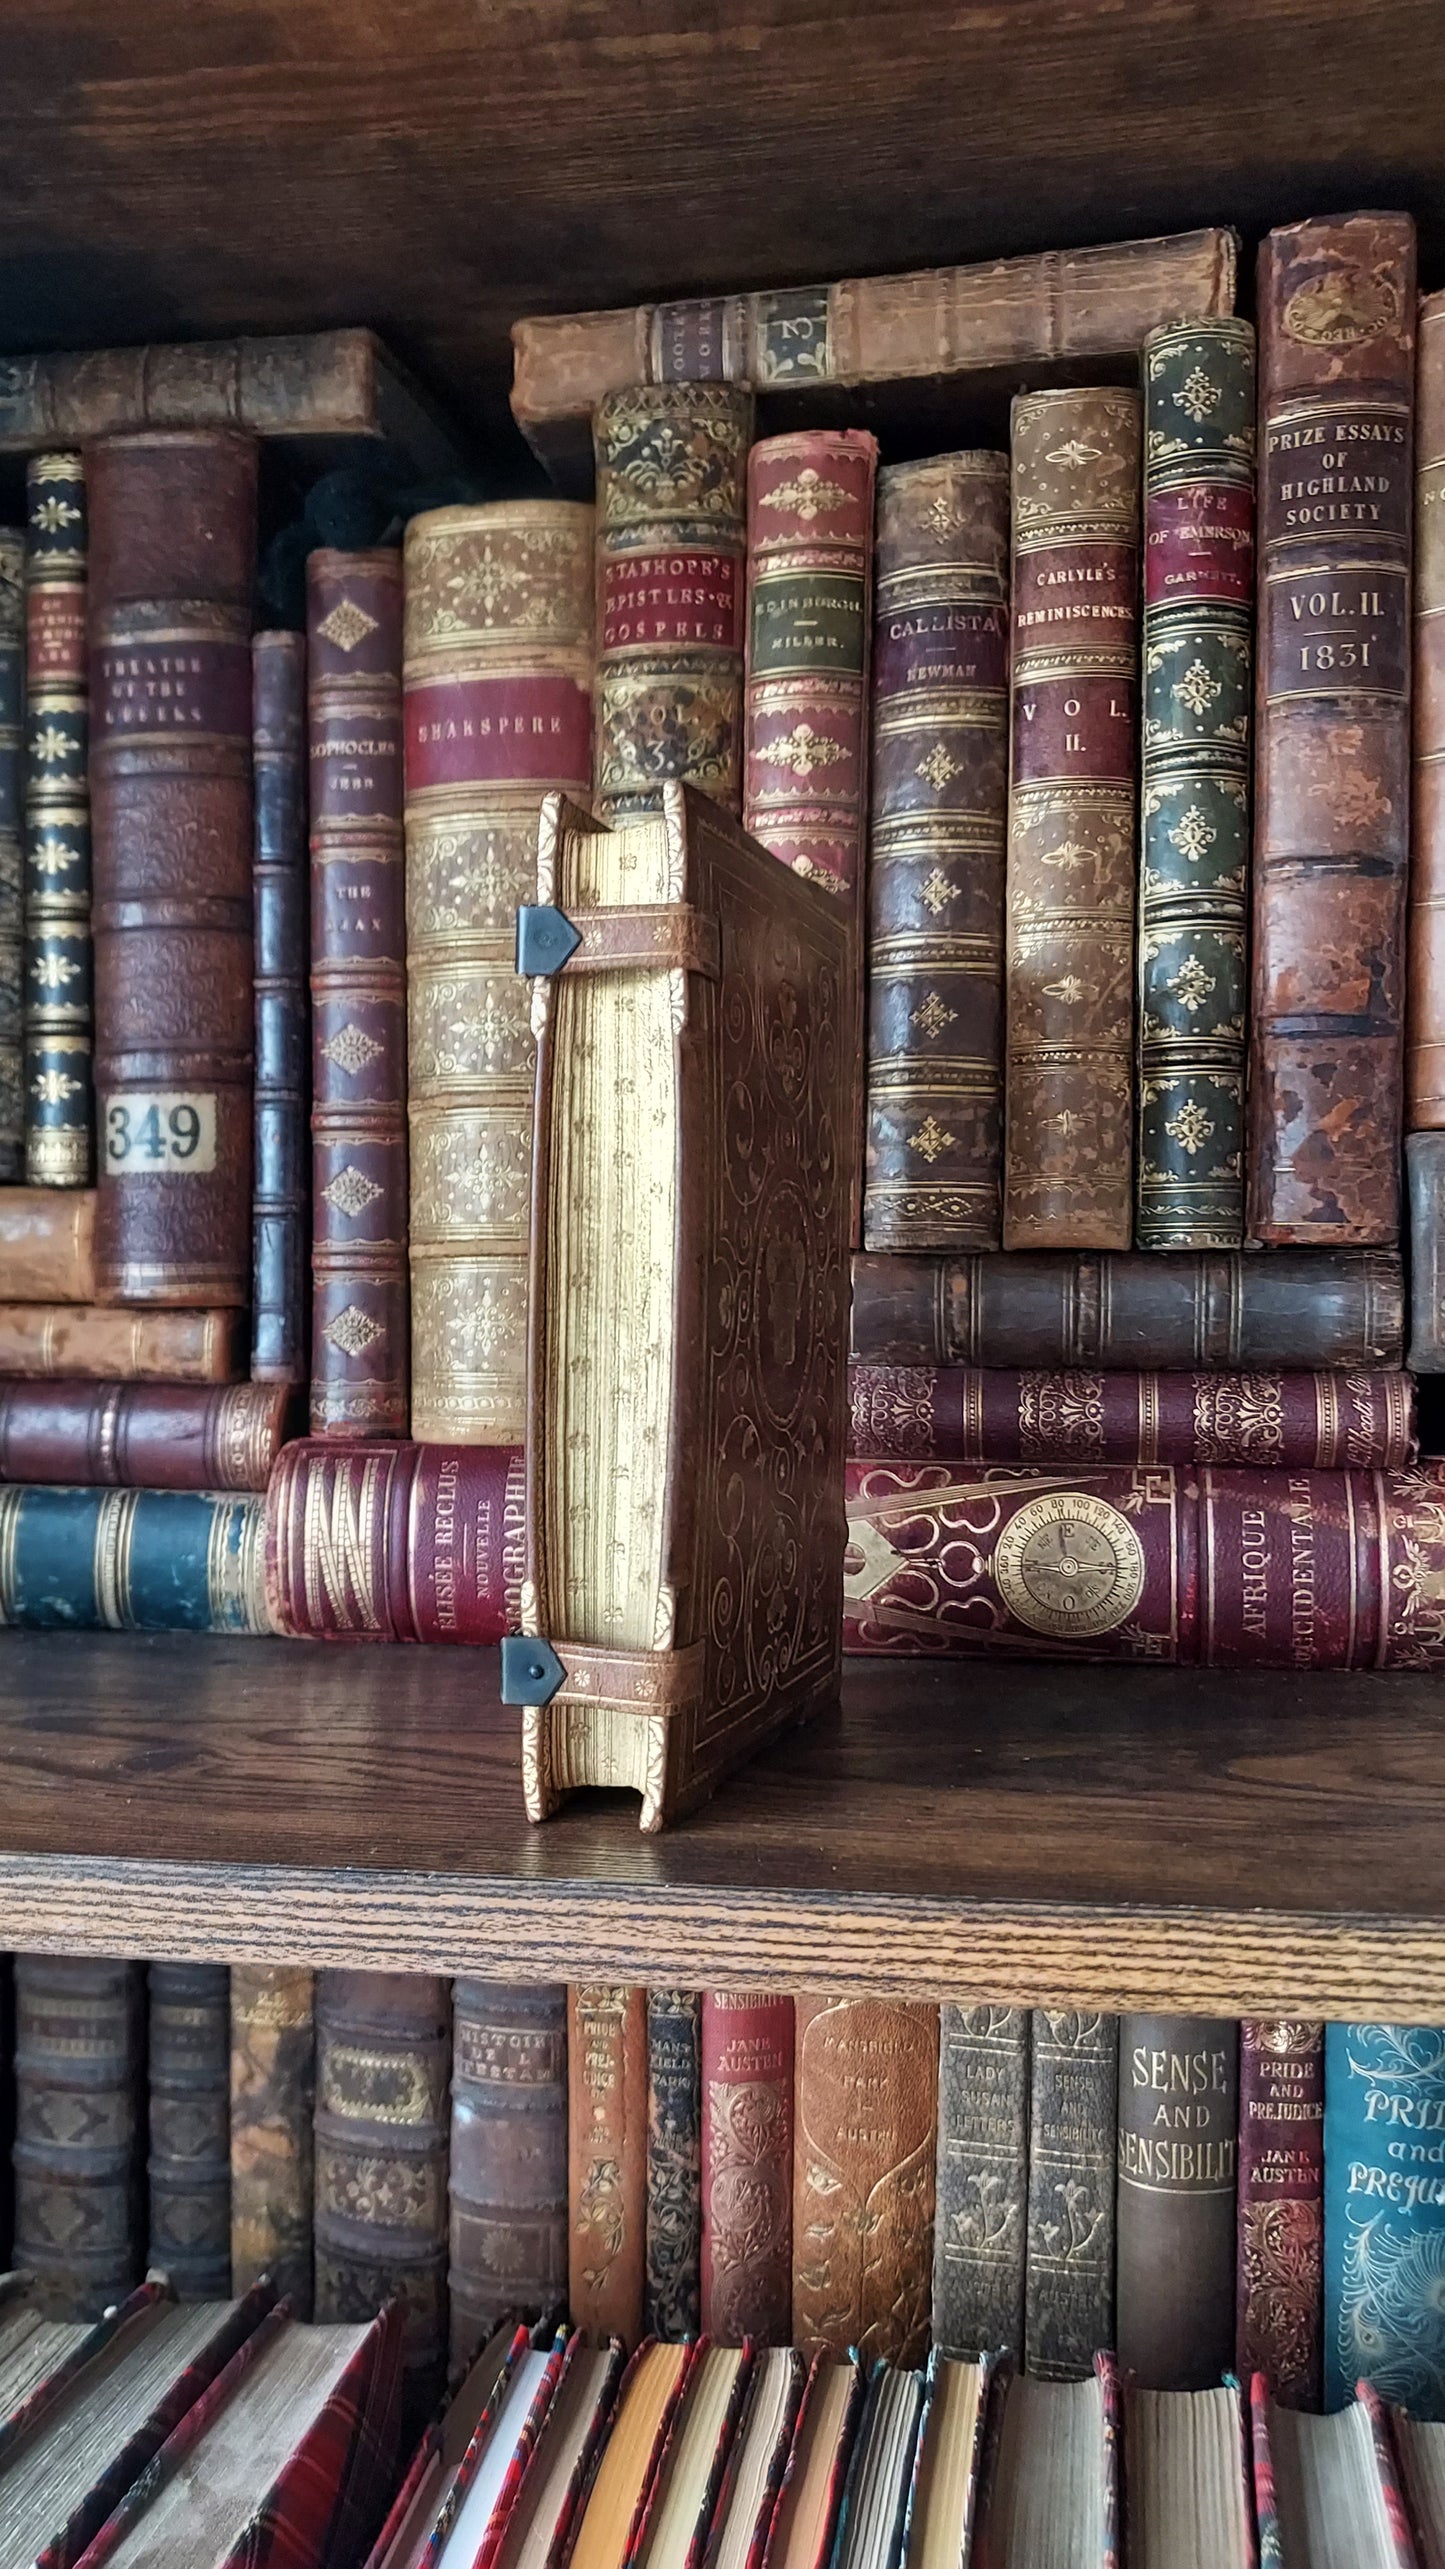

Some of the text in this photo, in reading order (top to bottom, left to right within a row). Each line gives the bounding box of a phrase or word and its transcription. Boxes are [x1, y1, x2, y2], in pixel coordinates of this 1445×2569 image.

[1268, 424, 1405, 453] PRIZE ESSAYS
[1322, 452, 1349, 470] OF
[1281, 475, 1391, 501] HIGHLAND
[1177, 495, 1227, 510] LIFE
[1285, 503, 1382, 526] SOCIETY
[1148, 529, 1169, 545] OF
[605, 558, 731, 584] STANHOPE'S
[1037, 562, 1116, 586] CARLYLE'S
[1290, 592, 1385, 621] VOL. II.
[605, 620, 724, 644] GOSPELS
[890, 615, 995, 640] CALLISTA
[1300, 643, 1370, 672] 1831
[907, 664, 976, 682] NEWMAN
[418, 716, 561, 743] SHAKSPERE
[1065, 734, 1086, 752] II.
[336, 886, 371, 900] THE
[107, 1104, 200, 1161] 349
[1030, 1505, 1044, 1517] 60
[1051, 1499, 1065, 1509] 80
[1072, 1499, 1090, 1510] 100
[1094, 1505, 1110, 1519] 120
[1014, 1517, 1027, 1530] 40
[1061, 1523, 1075, 1537] E
[1113, 1518, 1126, 1535] 140
[429, 1460, 459, 1630] ÉLISÉE RECLUS
[476, 1500, 490, 1599] NOUVELLE
[500, 1455, 525, 1637] ÉOGRAPHIE
[1003, 1535, 1015, 1549] 20
[1124, 1539, 1136, 1556] 160
[1000, 1555, 1009, 1575] 360
[1130, 1561, 1139, 1579] 180
[1289, 1478, 1315, 1670] OCCIDENTALE
[1242, 1510, 1272, 1639] AFRIQUE
[1124, 1583, 1137, 1601] 200
[584, 2021, 616, 2037] PRIDE
[727, 2038, 771, 2053] JANE
[717, 2052, 783, 2072] AUSTEN
[1132, 2046, 1227, 2095] SENSE
[1260, 2062, 1314, 2079] PRIDE
[967, 2065, 1006, 2080] LADY
[1055, 2074, 1094, 2090] SENSE
[1270, 2083, 1303, 2098] AND
[961, 2089, 1013, 2107] SUSAN
[1061, 2101, 1087, 2115] AND
[1153, 2104, 1210, 2128] AND
[1249, 2101, 1323, 2120] PREJUDICE
[956, 2114, 1015, 2133] LETTERS
[1261, 2149, 1310, 2163] JANE
[1387, 2139, 1445, 2163] and
[1250, 2166, 1319, 2184] AUSTEN
[1347, 2161, 1445, 2217] PREJU
